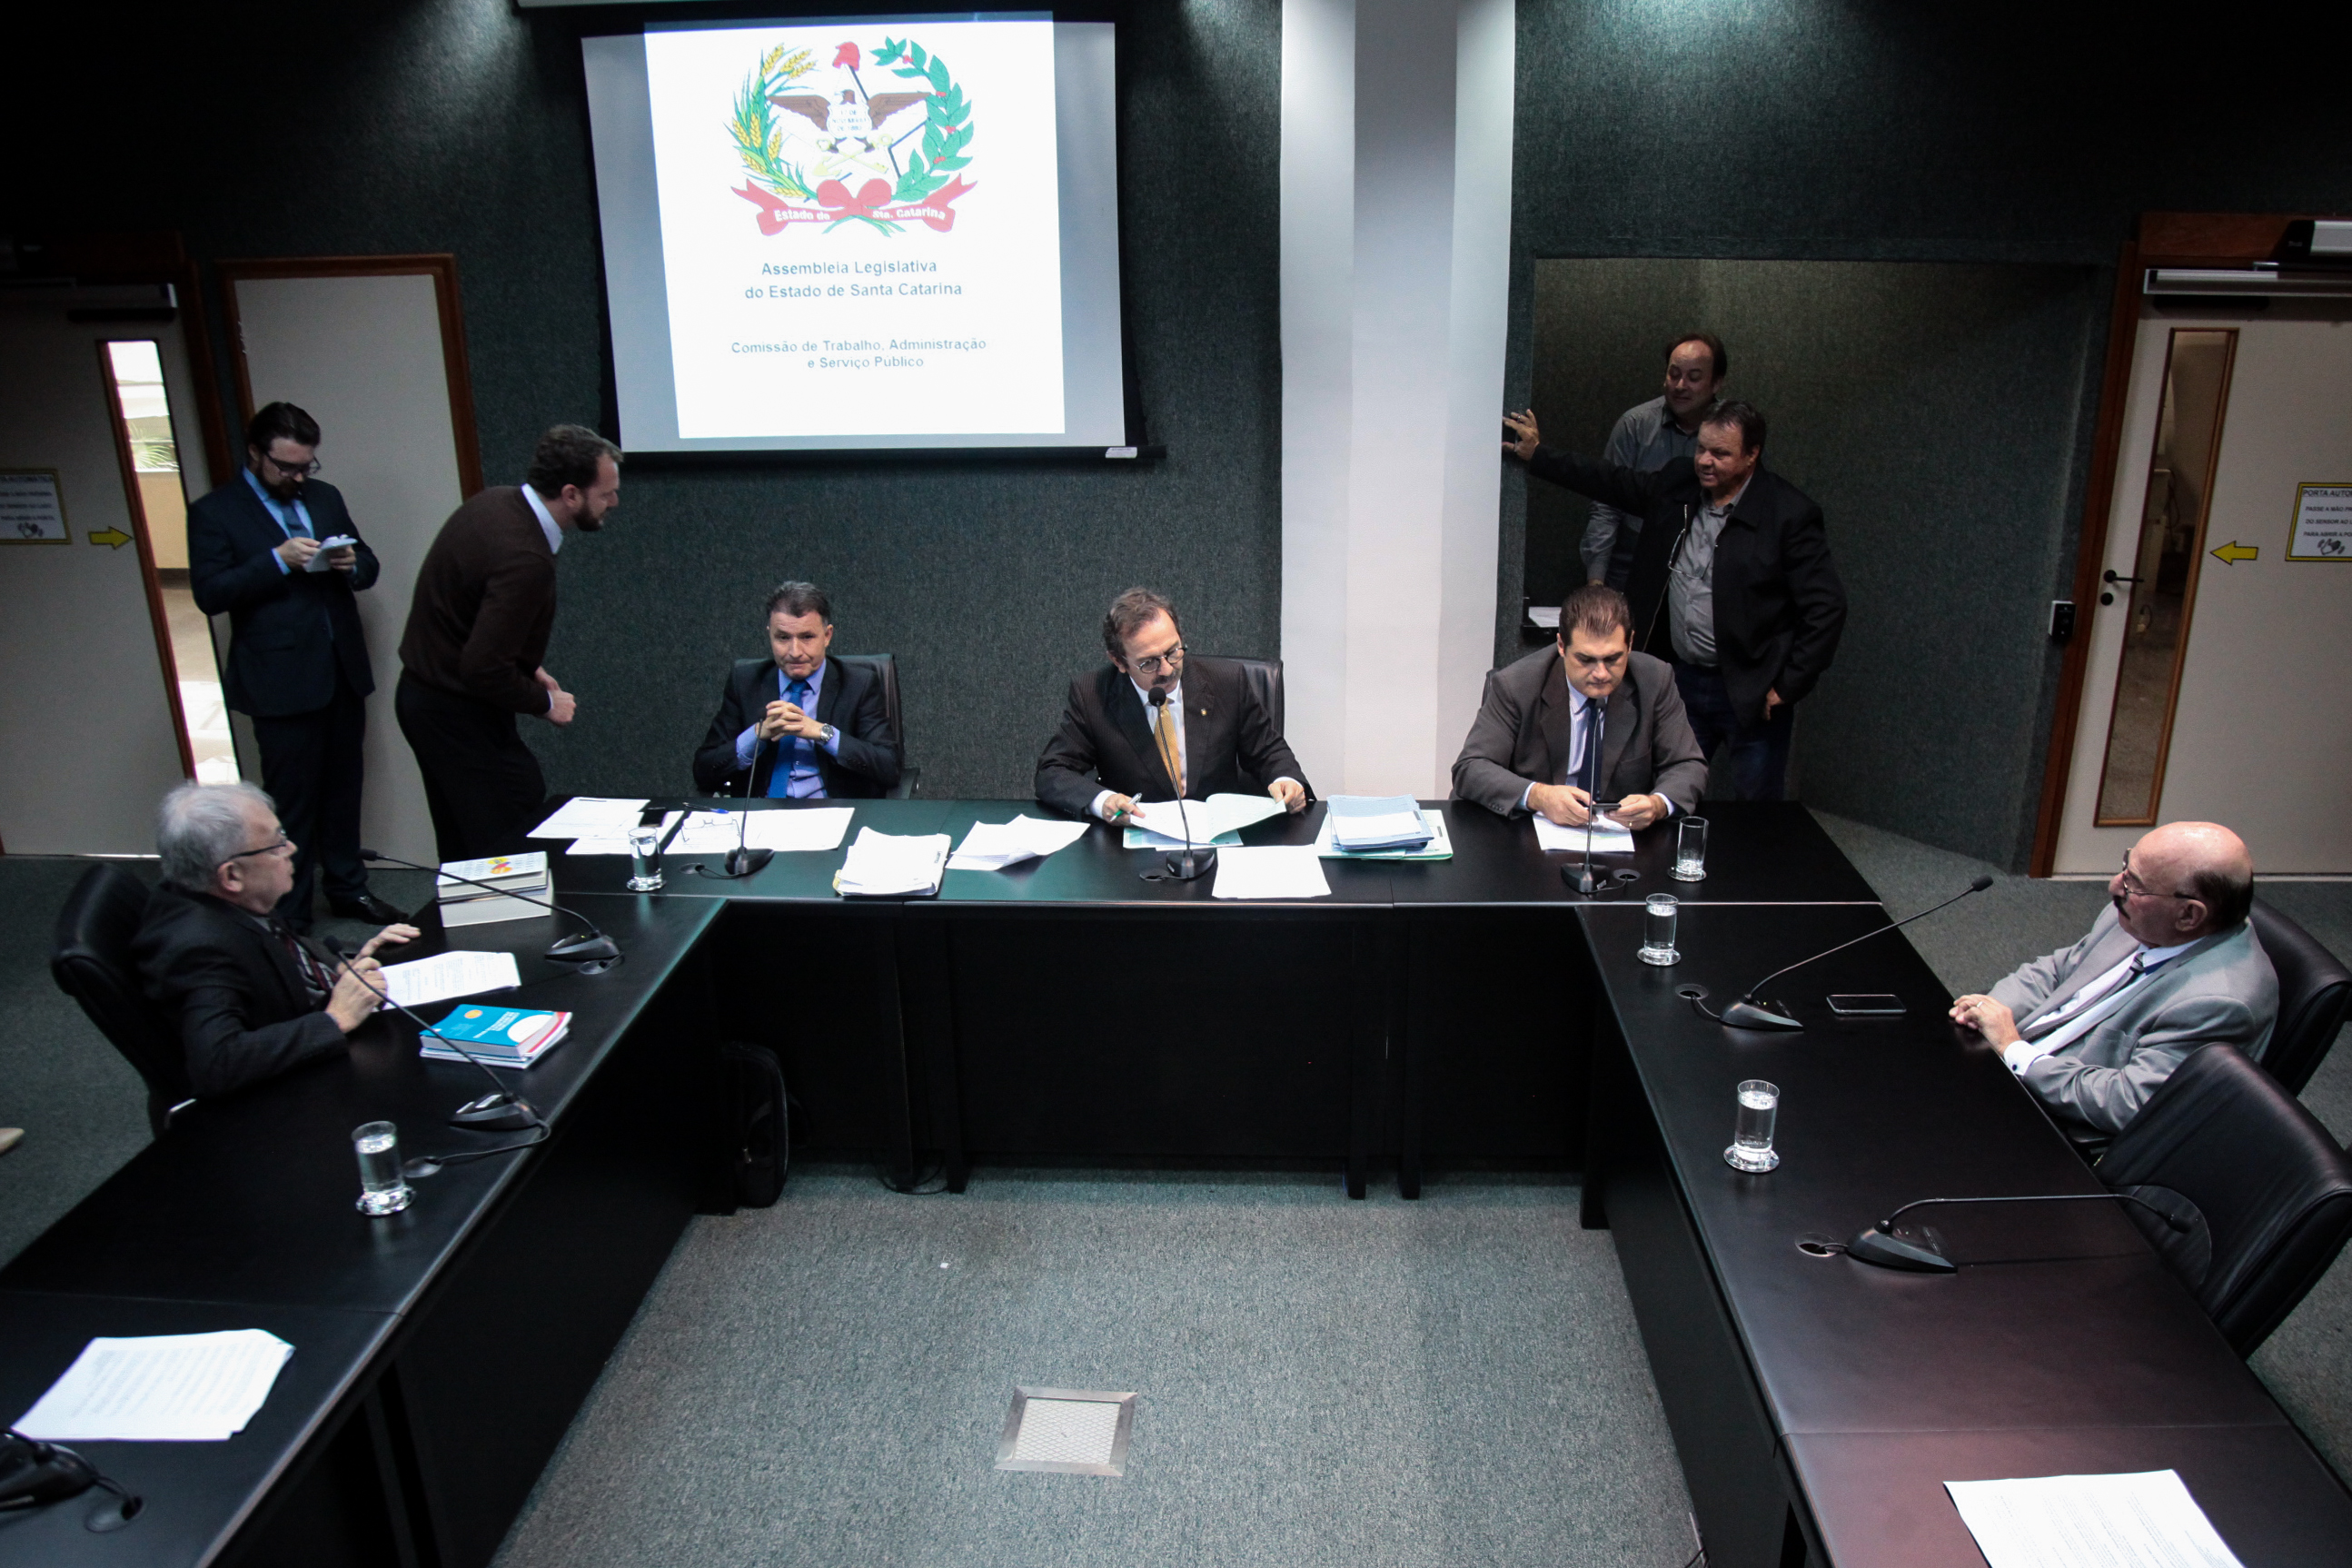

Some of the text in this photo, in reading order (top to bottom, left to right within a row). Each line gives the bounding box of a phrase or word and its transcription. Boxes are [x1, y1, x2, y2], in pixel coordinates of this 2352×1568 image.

[774, 209, 814, 222] Estado
[872, 207, 946, 221] Sta. Catarina
[761, 260, 937, 277] Assembleia Legislativa
[744, 282, 962, 299] do Estado de Santa Catarina
[731, 340, 798, 353] Comissão
[801, 341, 818, 352] de
[888, 337, 987, 352] Administração
[807, 360, 815, 369] e
[819, 356, 870, 370] Serviço
[2303, 489, 2328, 497] PORTA
